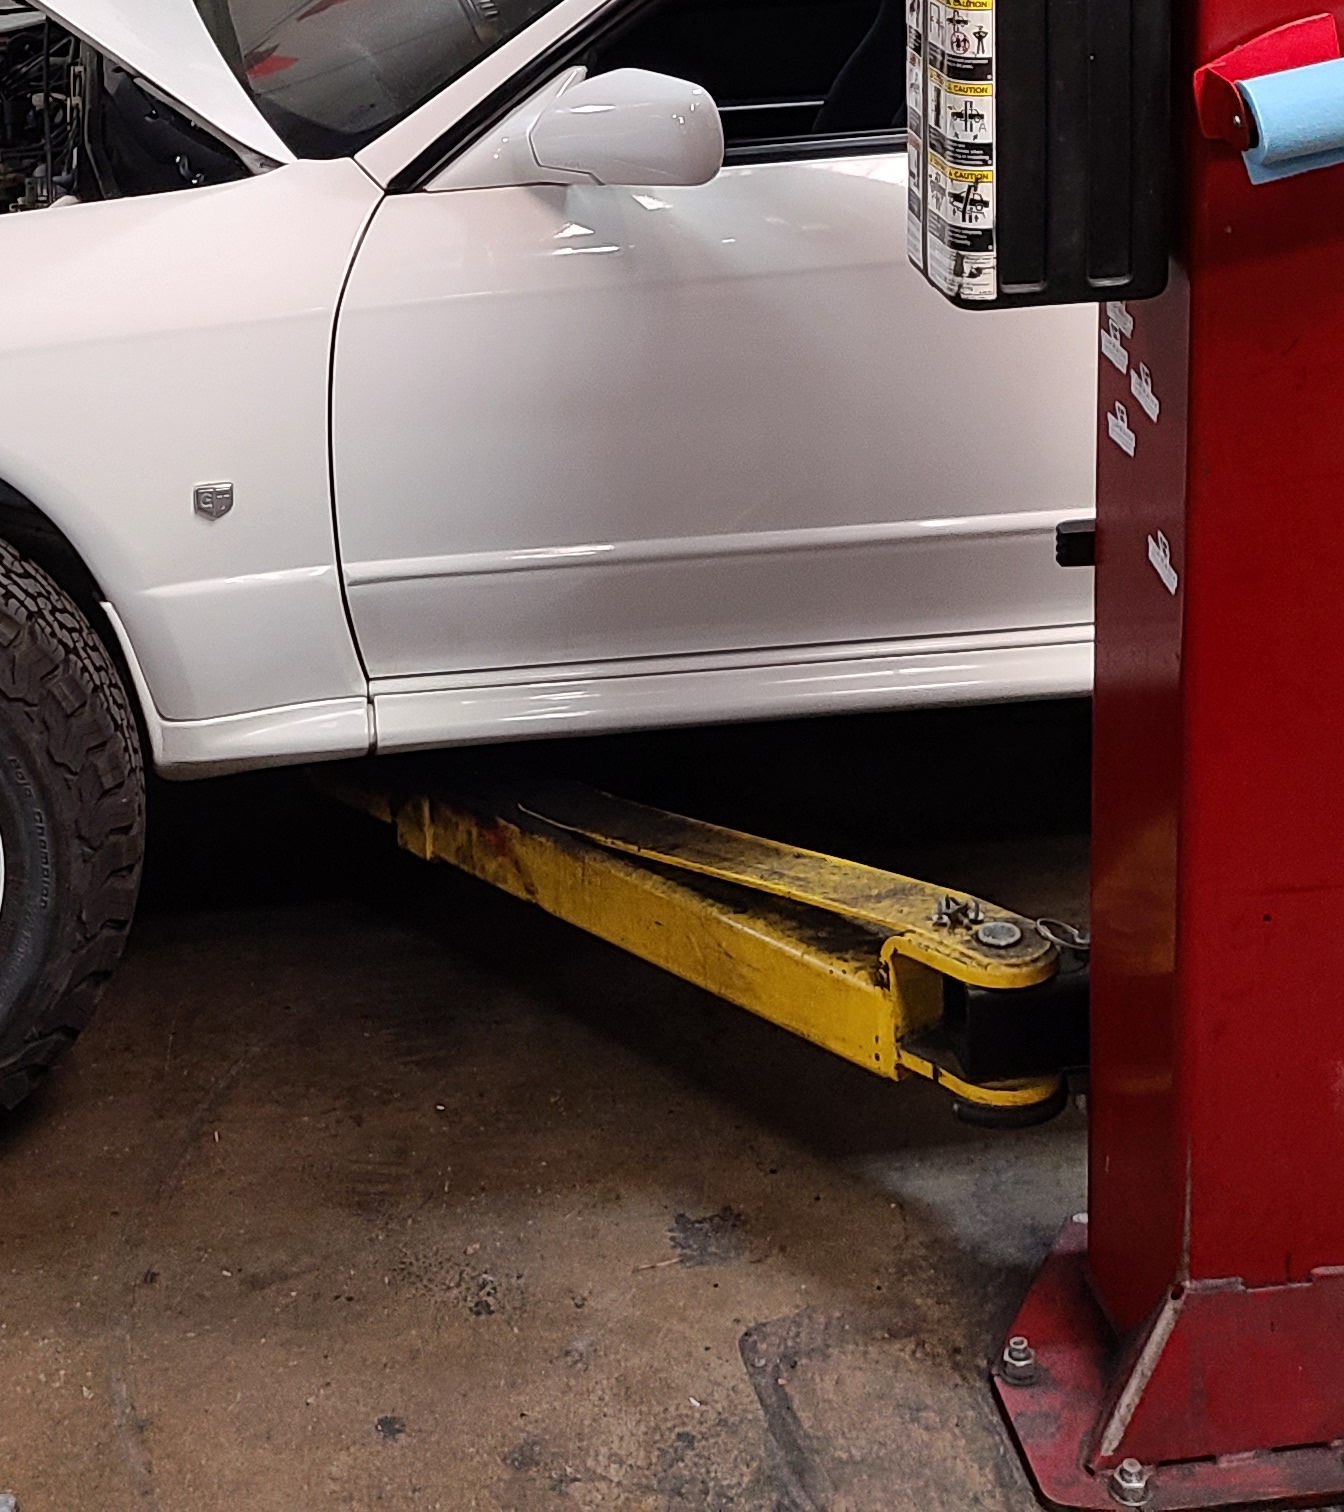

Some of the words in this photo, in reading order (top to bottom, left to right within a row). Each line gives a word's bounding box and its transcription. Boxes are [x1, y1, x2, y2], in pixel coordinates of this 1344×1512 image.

[953, 0, 988, 8] CAUTION
[954, 84, 988, 94] CAUTION
[954, 171, 989, 181] CAUTION
